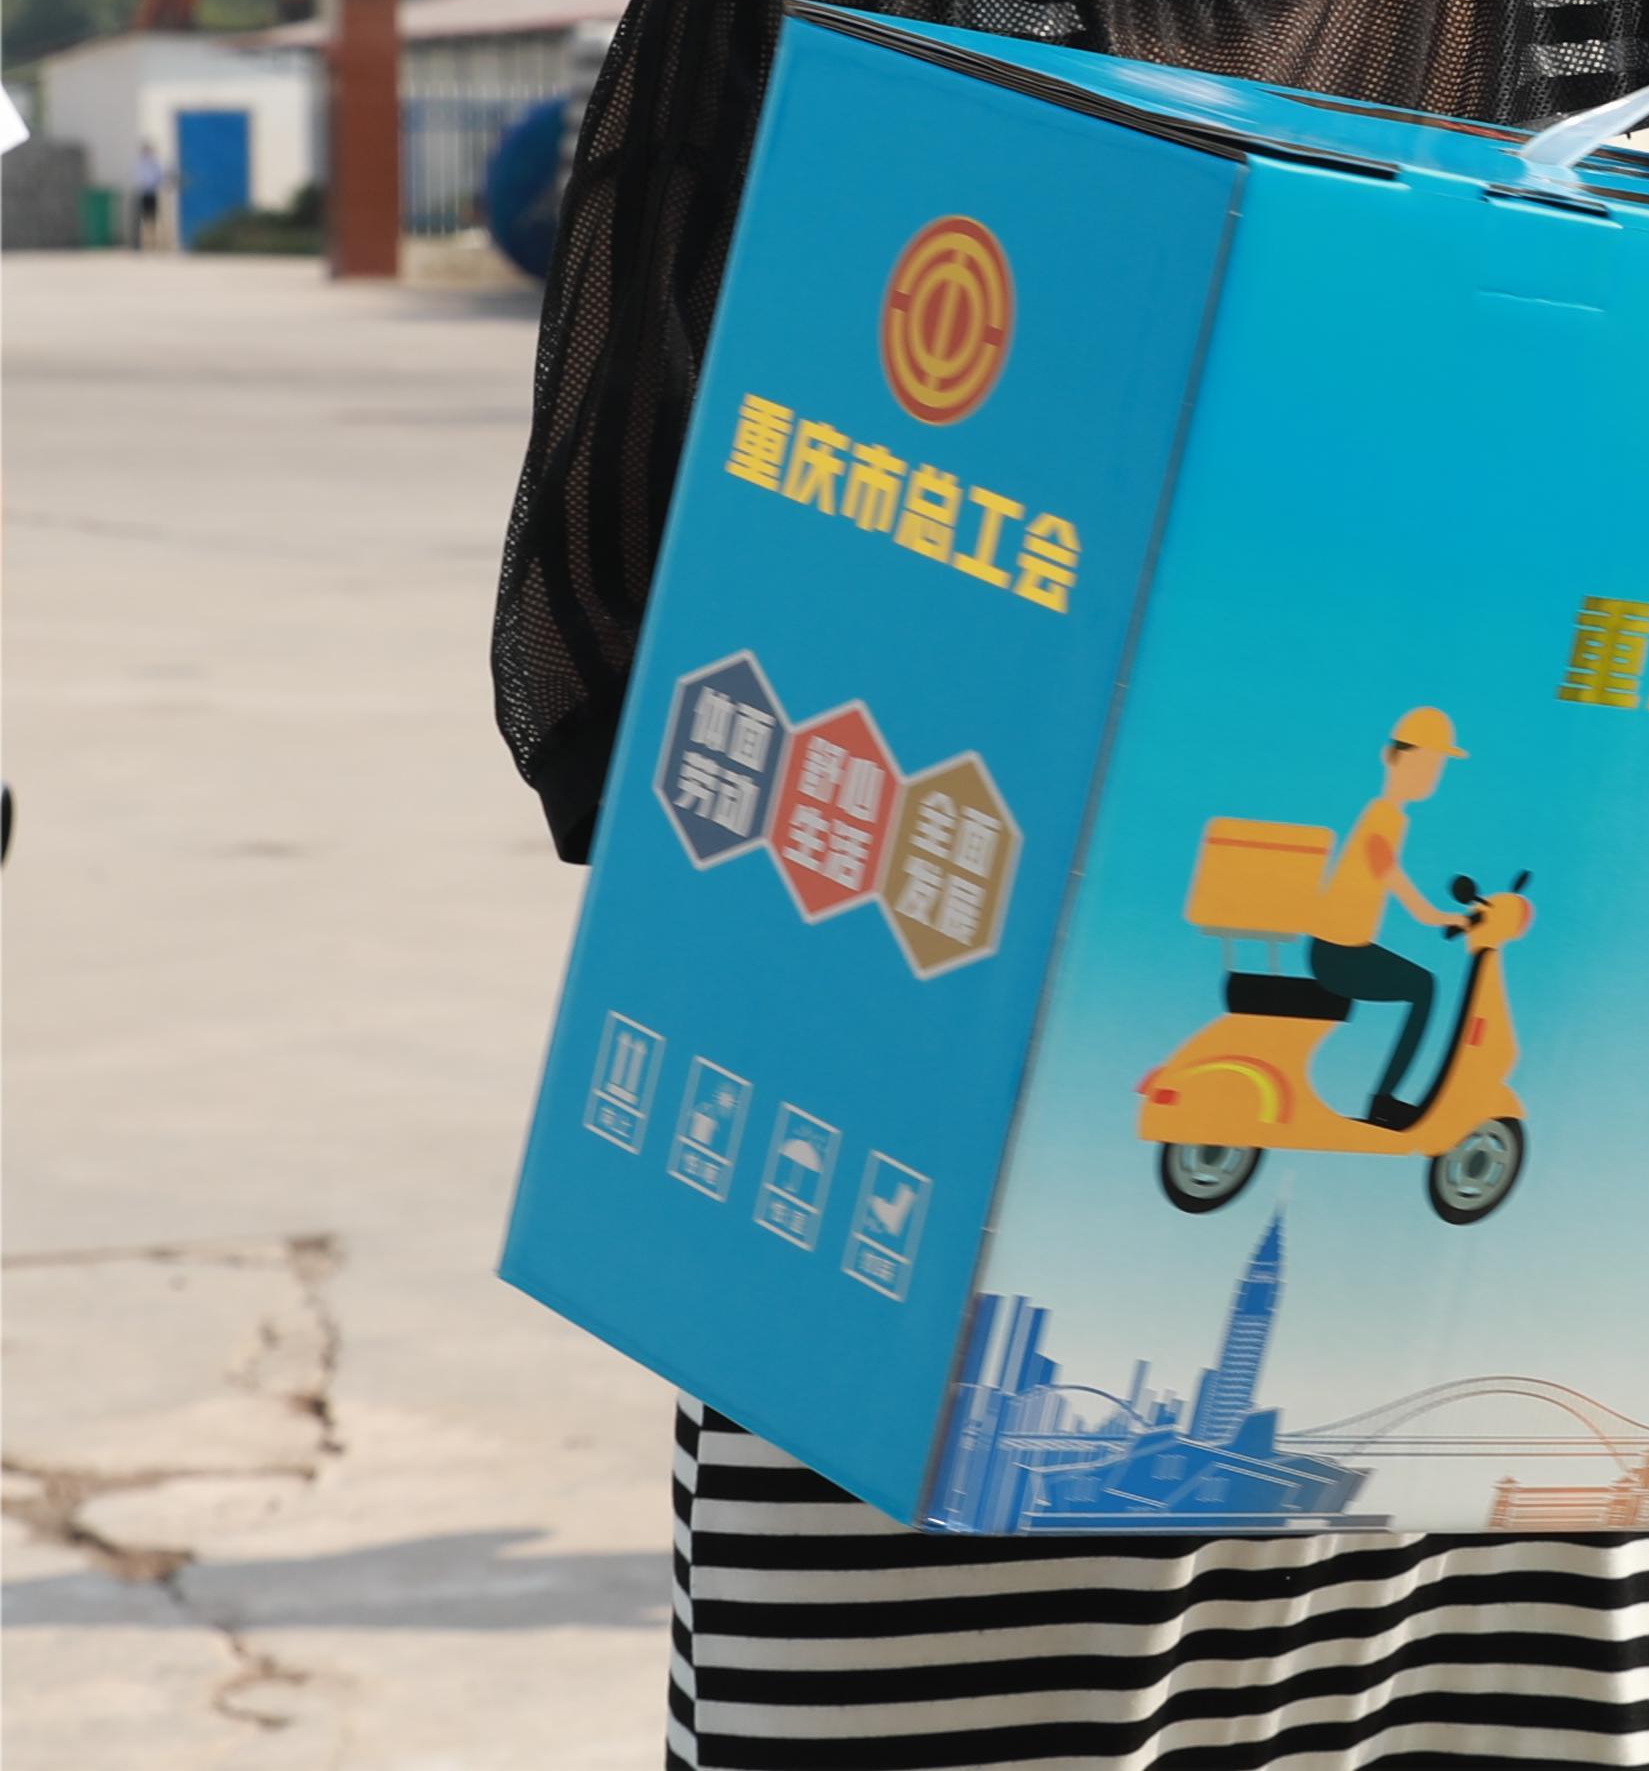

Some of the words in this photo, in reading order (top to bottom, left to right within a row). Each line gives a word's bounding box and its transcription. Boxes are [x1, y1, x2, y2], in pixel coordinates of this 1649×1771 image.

[724, 392, 1083, 615] 重庆市总工会
[797, 734, 887, 824] 舒心
[783, 803, 874, 892] 生活
[910, 790, 1003, 879] 全面
[894, 855, 987, 947] 发展
